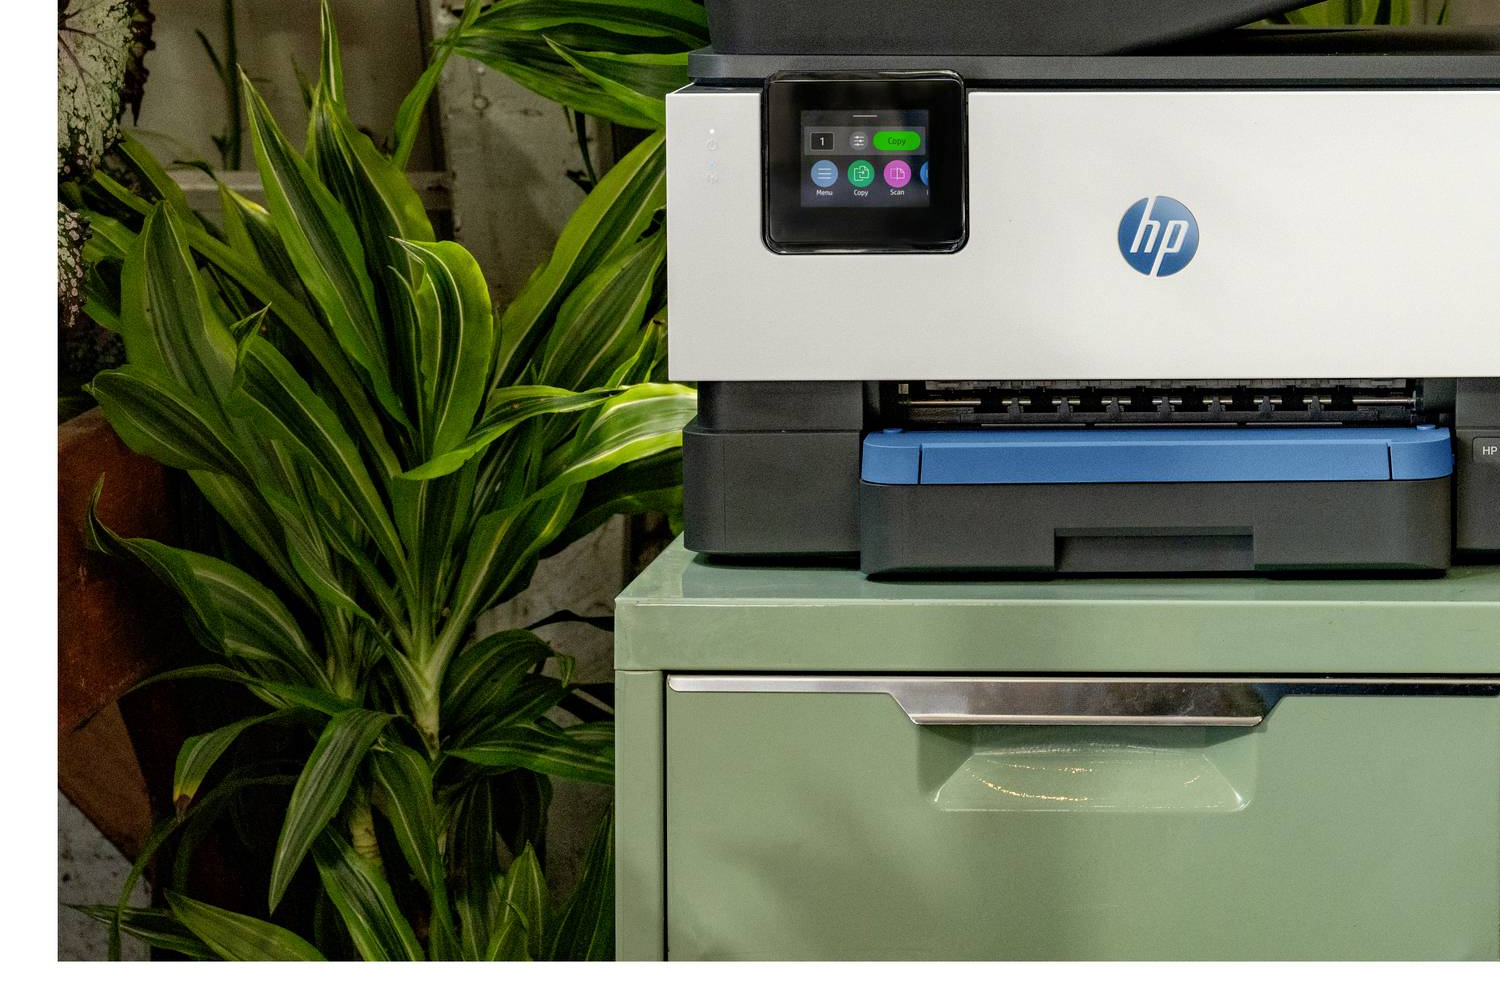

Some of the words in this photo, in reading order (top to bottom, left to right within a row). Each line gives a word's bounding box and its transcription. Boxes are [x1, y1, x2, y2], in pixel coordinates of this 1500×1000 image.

[887, 136, 907, 147] Copy
[816, 189, 833, 197] Menu
[853, 188, 869, 198] Copy
[889, 188, 905, 197] Scan
[1127, 195, 1191, 277] hp
[1481, 445, 1498, 456] HP
